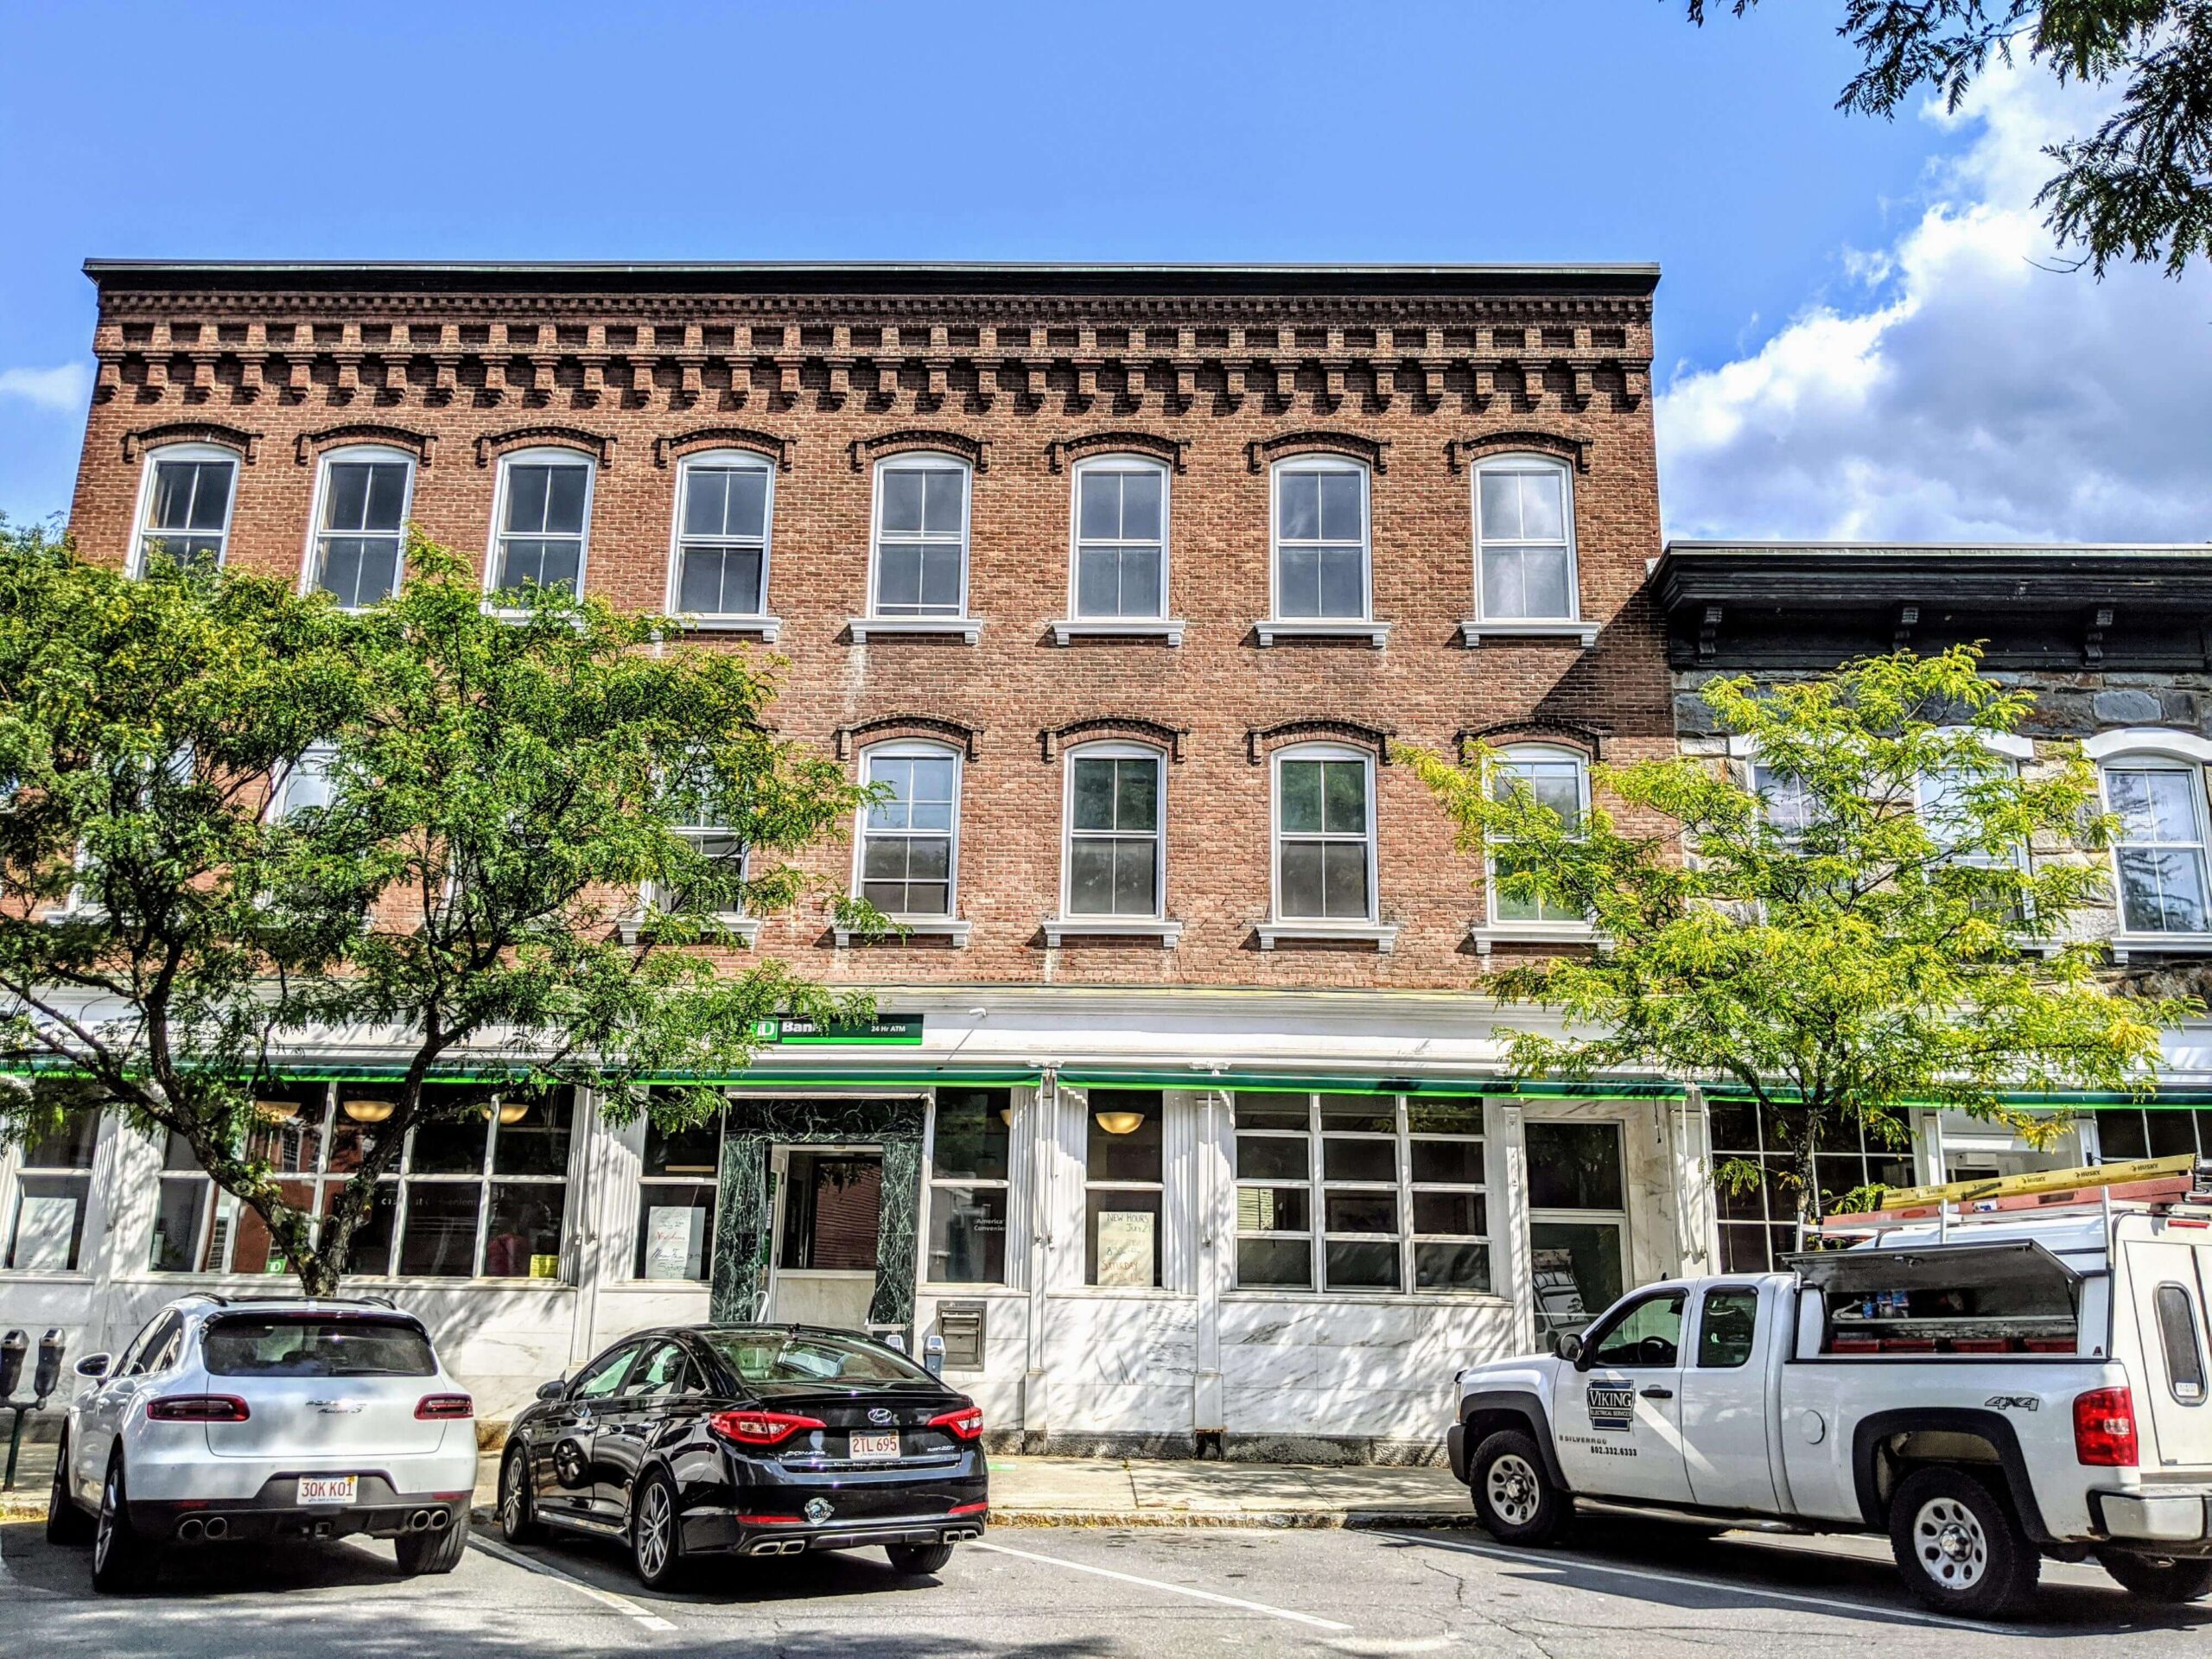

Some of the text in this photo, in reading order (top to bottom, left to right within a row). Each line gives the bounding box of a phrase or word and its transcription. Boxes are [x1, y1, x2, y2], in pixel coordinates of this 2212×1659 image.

[1107, 1213, 1149, 1224] NEW HOURS
[1590, 1391, 1631, 1407] VIKING
[853, 1437, 897, 1452] 2TL 695
[1591, 1446, 1637, 1456] 802.332.6333
